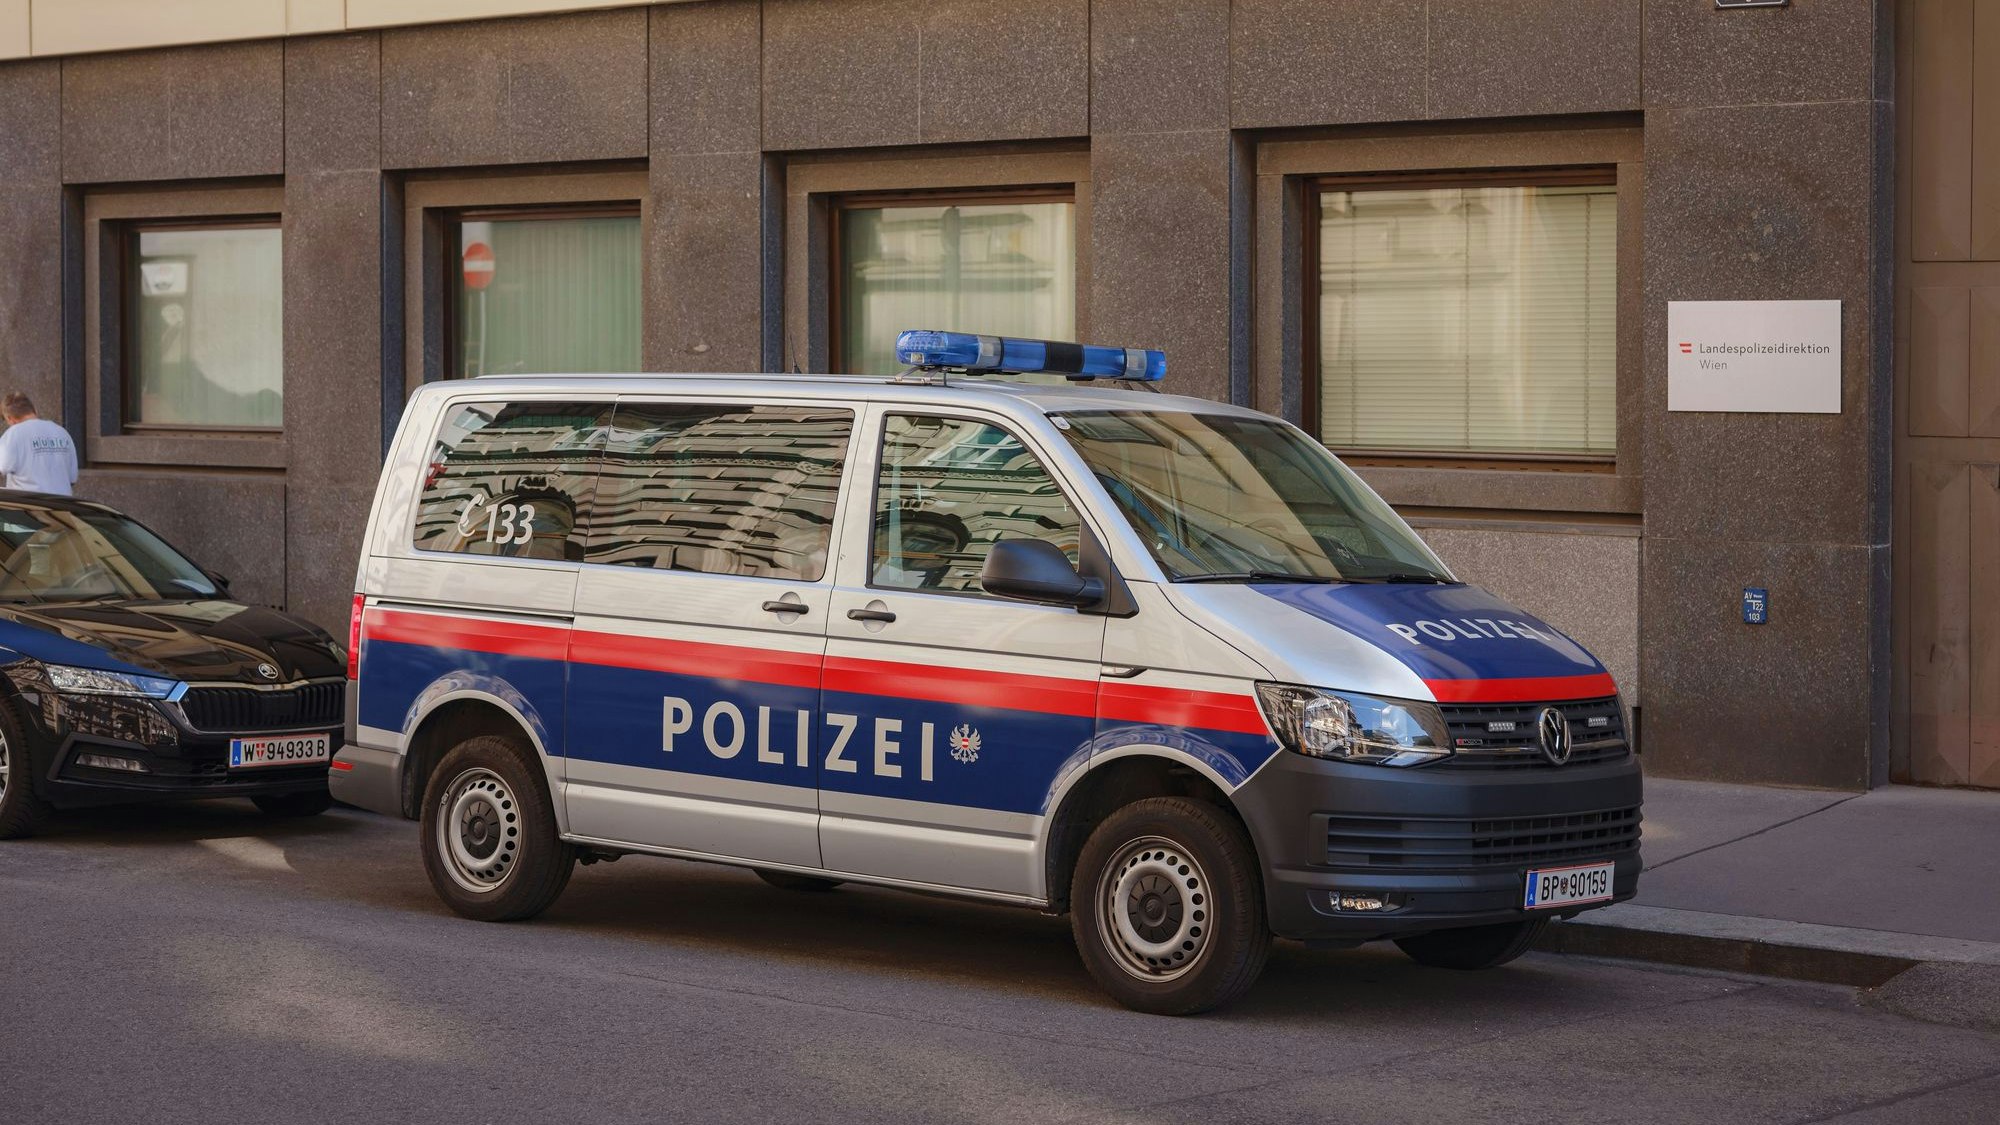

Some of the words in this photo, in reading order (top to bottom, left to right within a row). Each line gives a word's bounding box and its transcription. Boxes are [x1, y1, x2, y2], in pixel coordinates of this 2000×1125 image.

[1699, 342, 1830, 356] Landespolizeidirektion
[1699, 359, 1728, 370] Wien
[485, 503, 536, 545] 133
[1385, 618, 1551, 645] POLIZEI
[243, 743, 255, 762] W
[266, 740, 314, 760] 94933
[317, 740, 325, 757] B
[662, 696, 934, 782] POLIZEI
[1541, 876, 1560, 901] BP
[1569, 870, 1607, 898] 90159
